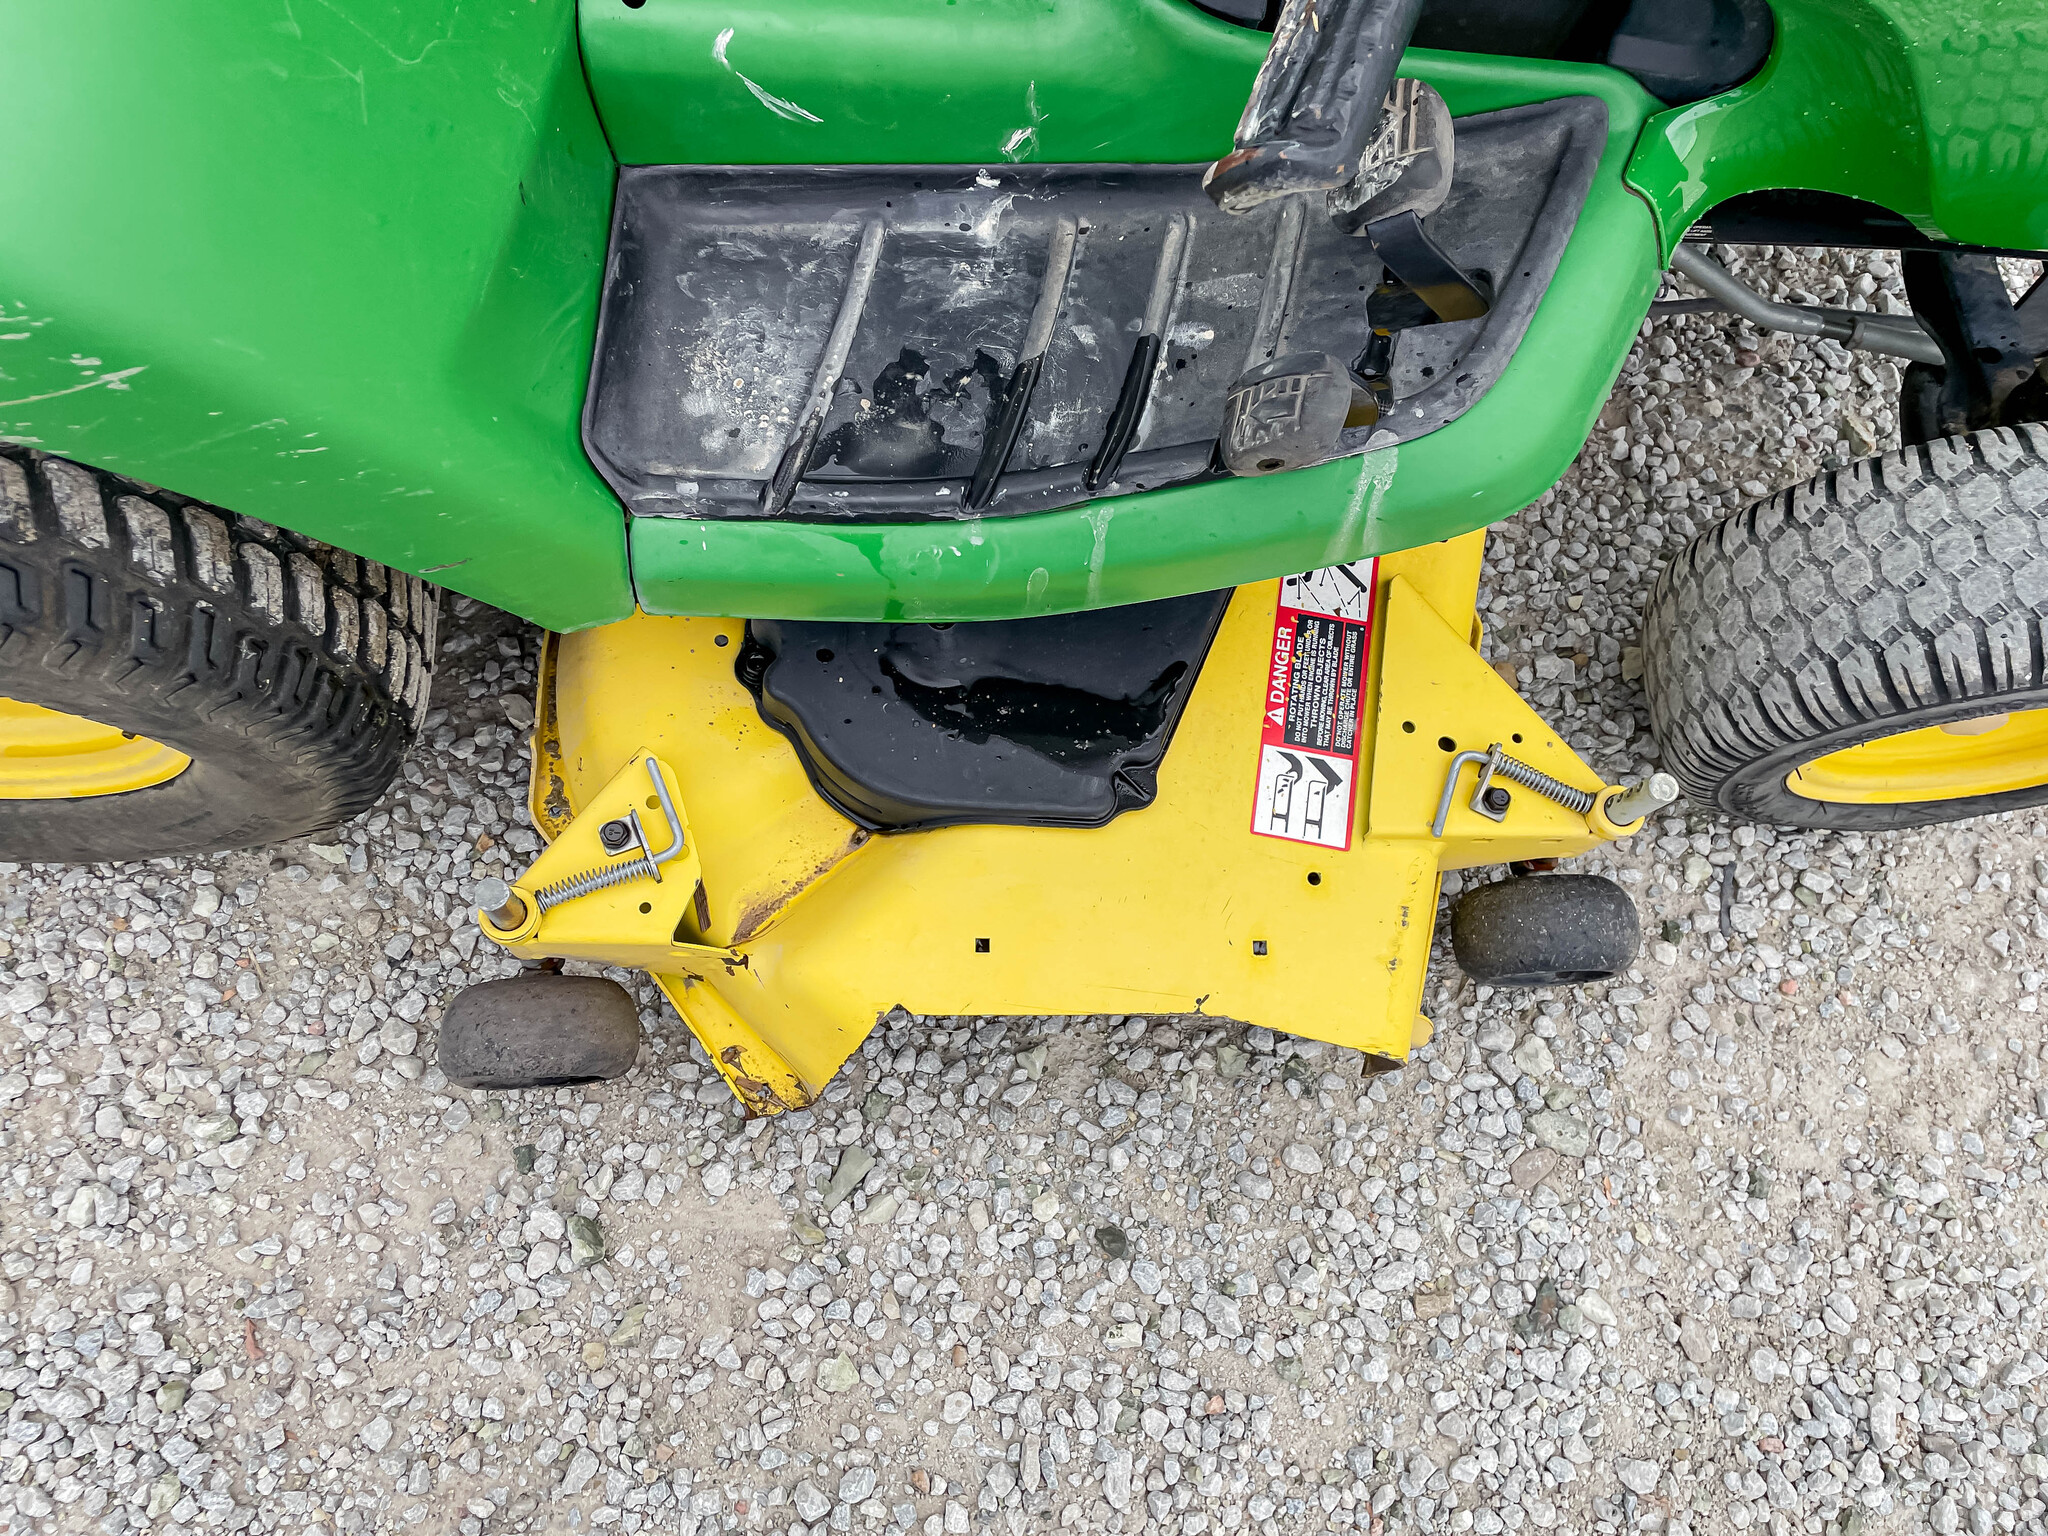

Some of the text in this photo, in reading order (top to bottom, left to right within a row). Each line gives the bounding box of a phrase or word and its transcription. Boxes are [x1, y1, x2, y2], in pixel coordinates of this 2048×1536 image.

[1307, 620, 1313, 629] OR
[1327, 624, 1335, 649] OBJECTS
[1270, 627, 1292, 704] DANGER
[1326, 651, 1332, 659] OF
[1289, 636, 1304, 722] ROTATING BLADE
[1302, 670, 1308, 680] OR
[1303, 702, 1311, 726] MOWER
[1308, 657, 1316, 681] ENGINE
[1312, 621, 1320, 648] RUNNING
[1310, 638, 1326, 728] THROWN OBJECTS
[1322, 676, 1330, 695] CLEAR
[1331, 669, 1337, 678] BY
[1299, 680, 1307, 702] HANDS
[1328, 678, 1336, 705] THROWN
[1335, 736, 1341, 747] DO
[1338, 689, 1346, 719] OPERATE
[1344, 630, 1352, 660] WITHOUT
[1327, 706, 1333, 716] BE
[1341, 711, 1349, 748] DISCHARGE
[1347, 678, 1353, 687] OR
[1346, 689, 1358, 749] CATCHER IN PLACE
[1295, 731, 1301, 742] DO
